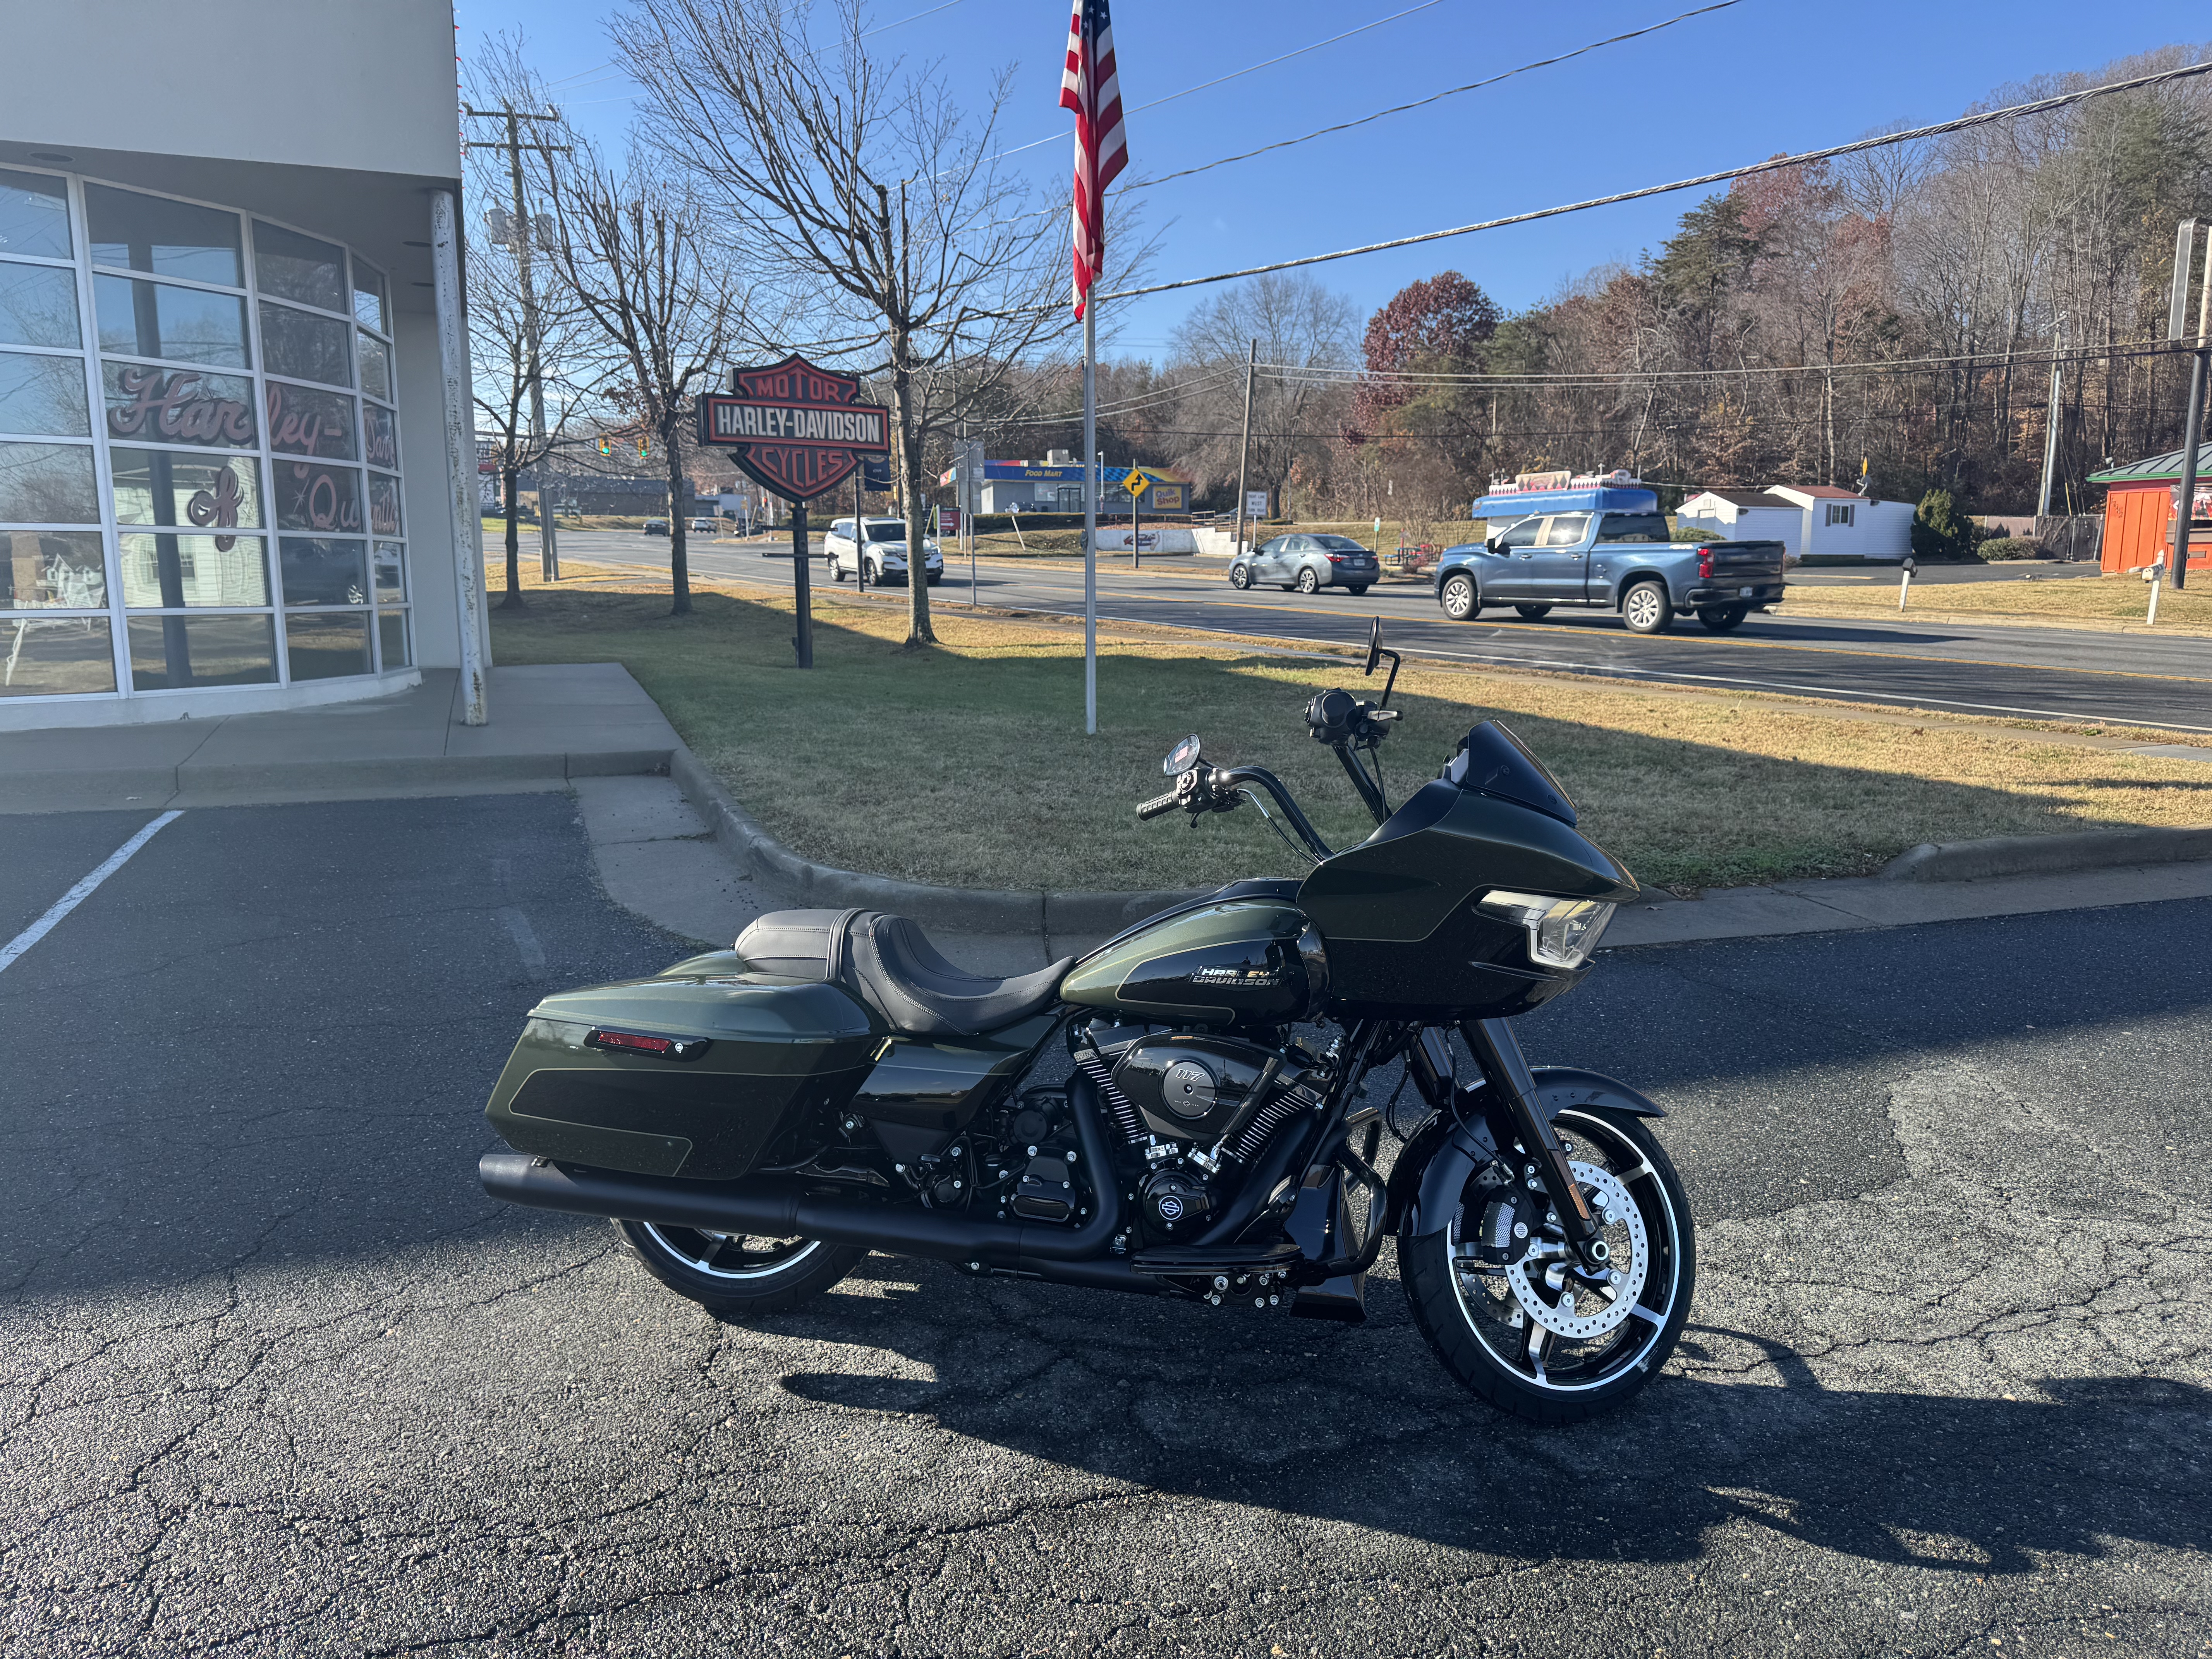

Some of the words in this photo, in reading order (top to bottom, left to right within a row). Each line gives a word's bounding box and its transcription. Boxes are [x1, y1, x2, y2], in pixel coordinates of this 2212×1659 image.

[755, 366, 842, 403] MOTOR
[717, 405, 880, 443] HARLEY-DAVIDSON
[761, 447, 843, 488] CYCLES
[1156, 488, 1175, 498] Quik
[1157, 496, 1180, 505] Shop
[187, 466, 244, 552] of
[1192, 976, 1279, 986] DAVIDSON
[1176, 1068, 1205, 1081] 117
